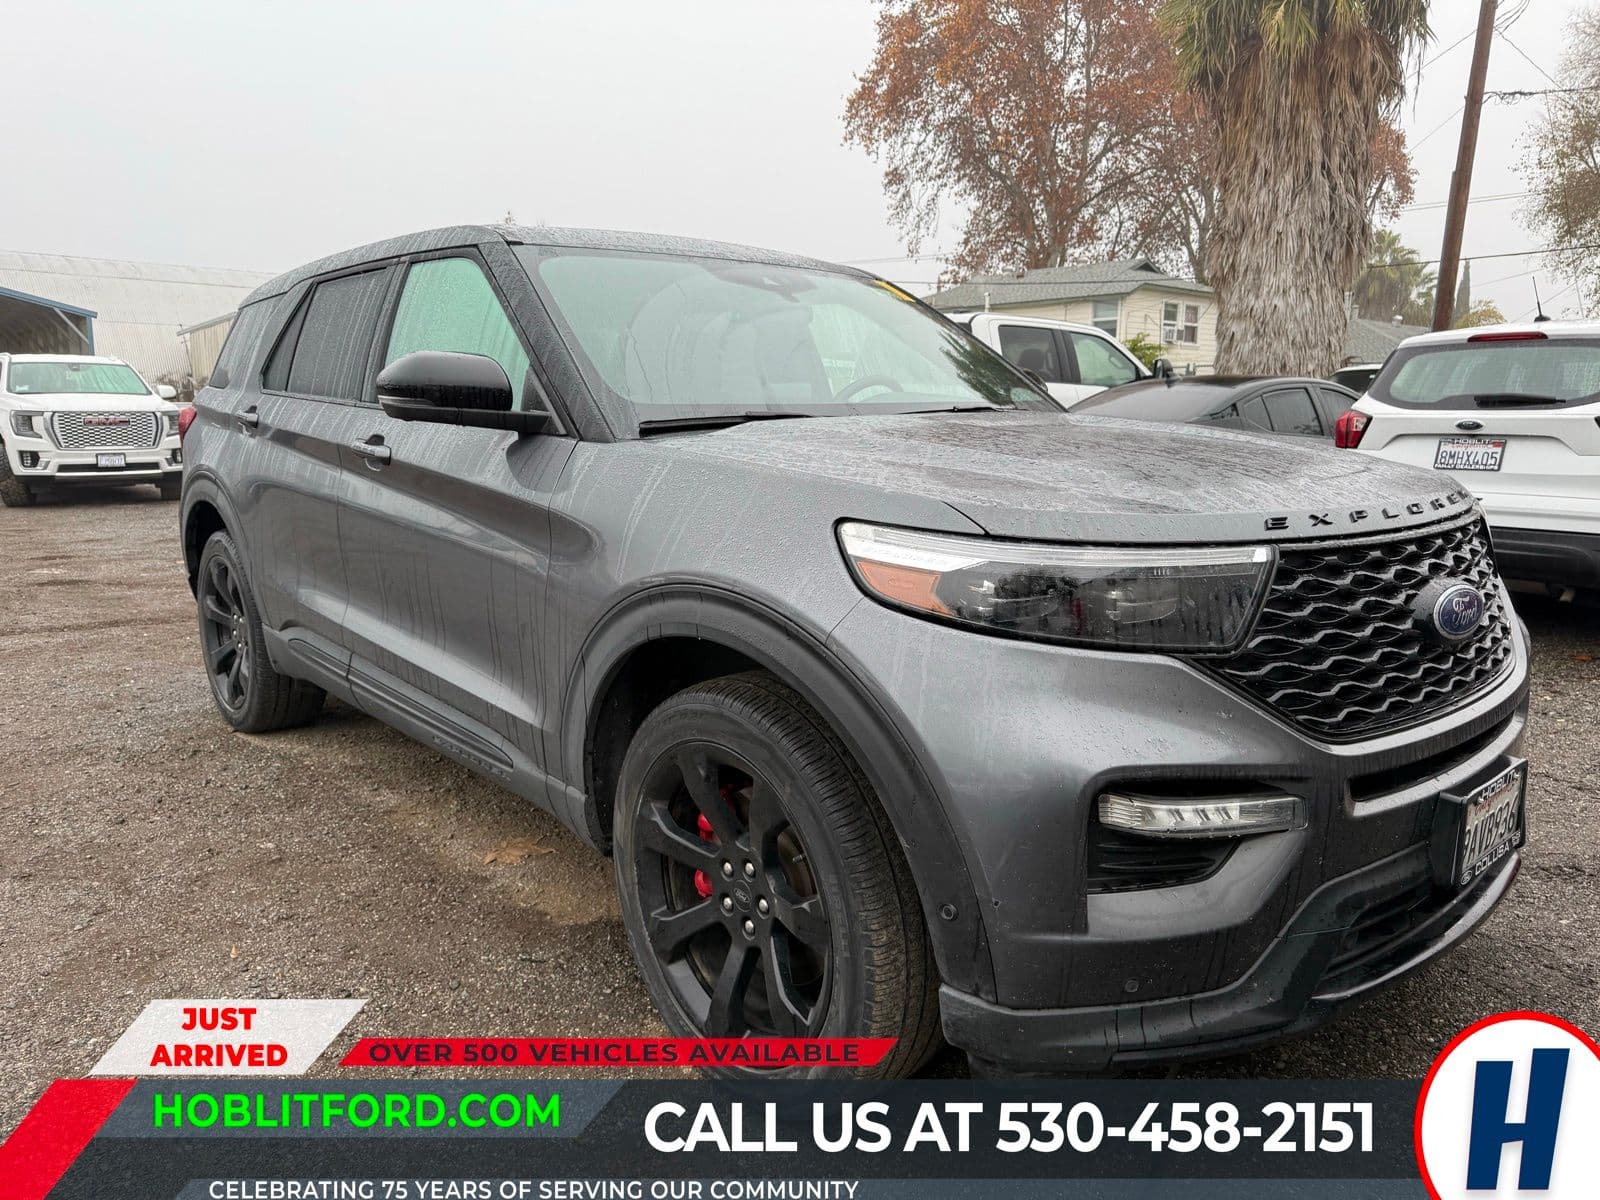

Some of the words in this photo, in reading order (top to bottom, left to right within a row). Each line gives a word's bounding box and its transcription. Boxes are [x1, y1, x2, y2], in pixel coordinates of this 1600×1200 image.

[1439, 450, 1499, 467] 8MHX405
[1481, 768, 1516, 799] HOBLIT
[1475, 841, 1510, 876] COLUSA
